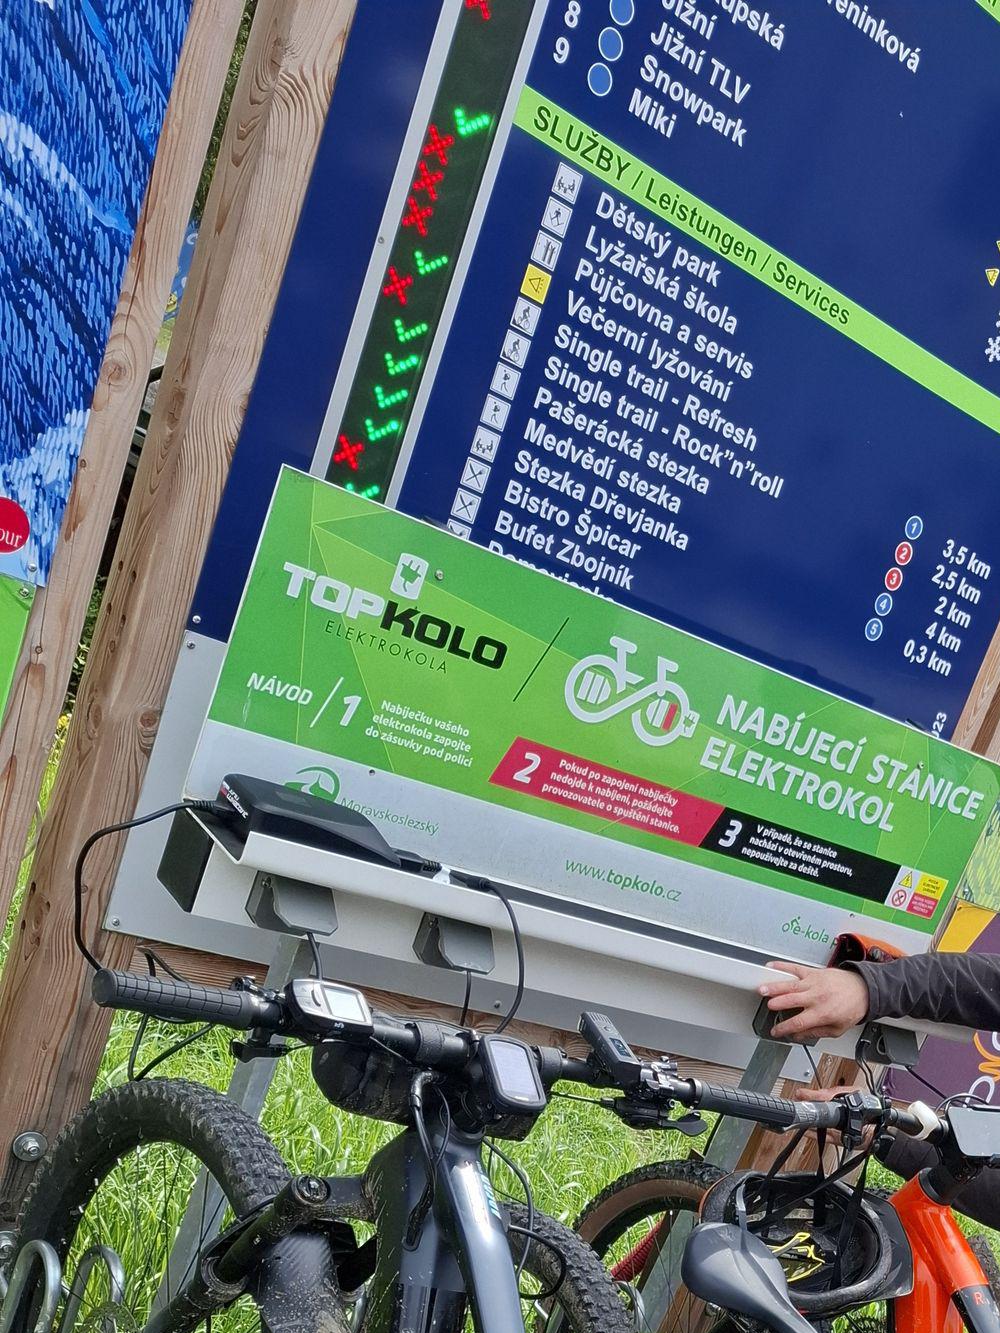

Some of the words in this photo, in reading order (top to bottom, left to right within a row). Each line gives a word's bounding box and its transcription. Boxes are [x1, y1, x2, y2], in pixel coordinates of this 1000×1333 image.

[564, 1, 581, 28] 8
[553, 37, 570, 64] 9
[650, 22, 706, 74] Jižní
[709, 58, 751, 104] TLV
[628, 88, 677, 138] Miki
[640, 54, 747, 147] Snowpark
[533, 105, 631, 183] SLUŽBY
[645, 177, 757, 266] Leistungen
[773, 262, 850, 325] Services
[595, 191, 671, 256] Dětský
[673, 249, 721, 288] park
[584, 225, 681, 300] Lyžařská
[684, 287, 738, 335] škola
[567, 290, 645, 352] Večerní
[649, 341, 734, 403] lyžování
[575, 258, 673, 330] Půjčovna
[677, 323, 691, 343] a
[693, 332, 754, 379] servis
[544, 357, 611, 410] Single
[616, 395, 658, 434] trail
[553, 324, 622, 380] Single
[627, 364, 670, 401] trail
[683, 397, 758, 452] Refresh
[523, 419, 615, 478] Medvědí
[617, 472, 682, 514] stezka
[533, 386, 645, 461] Pašerácká
[647, 452, 710, 495] stezka
[504, 480, 568, 526] Bistro
[574, 512, 641, 560] Špicar
[514, 451, 585, 501] Stezka
[593, 484, 690, 552] Dřevjanka
[494, 511, 555, 555] Bufet
[556, 538, 635, 591] Zbojník
[900, 548, 908, 560] 2
[931, 564, 958, 591] 2,5
[957, 577, 982, 605] km
[942, 538, 969, 565] 3,5
[966, 552, 992, 581] km
[283, 561, 508, 670] TOPKOLO
[880, 599, 888, 610] 4
[925, 621, 939, 640] 4
[937, 626, 962, 653] km
[890, 573, 898, 585] 3
[934, 596, 945, 616] 2
[947, 601, 972, 629] km
[325, 620, 448, 675] ELEKTROKOLA
[869, 624, 878, 636] 5
[903, 639, 928, 664] 0,3
[927, 650, 952, 677] km
[246, 671, 313, 705] NÁVOD
[339, 695, 362, 727] 1
[381, 700, 433, 725] Nabíječku
[434, 719, 470, 738] vašeho
[365, 725, 379, 738] do
[380, 731, 422, 753] zásuvky
[423, 745, 444, 759] pod
[372, 713, 433, 740] elektrokola
[433, 733, 472, 753] zapojte
[716, 694, 868, 775] NABÍJECÍ
[866, 753, 984, 821] STANICE
[512, 752, 542, 784] 2
[558, 758, 587, 776] Pokud
[588, 768, 600, 781] po
[601, 773, 638, 794] zapojení
[638, 787, 678, 807] nabíječky
[549, 771, 587, 790] nedojde
[587, 778, 595, 792] k
[631, 795, 673, 818] požádejte
[700, 735, 894, 833] ELEKTROKOL
[541, 783, 605, 811] provozovatele
[606, 803, 613, 812] o
[613, 804, 650, 824] spuštění
[649, 817, 680, 835] stanice.
[718, 819, 743, 848] 3
[757, 824, 765, 835] V
[793, 836, 803, 848] že
[811, 844, 838, 858] stanice
[742, 847, 788, 870] nepoužívejte
[788, 861, 797, 869] za
[749, 836, 777, 852] nachází
[784, 846, 821, 867] otevřeném
[821, 859, 853, 877] prostoru,
[565, 858, 682, 903] www.topkolo.cz
[793, 925, 829, 943] e-kola
